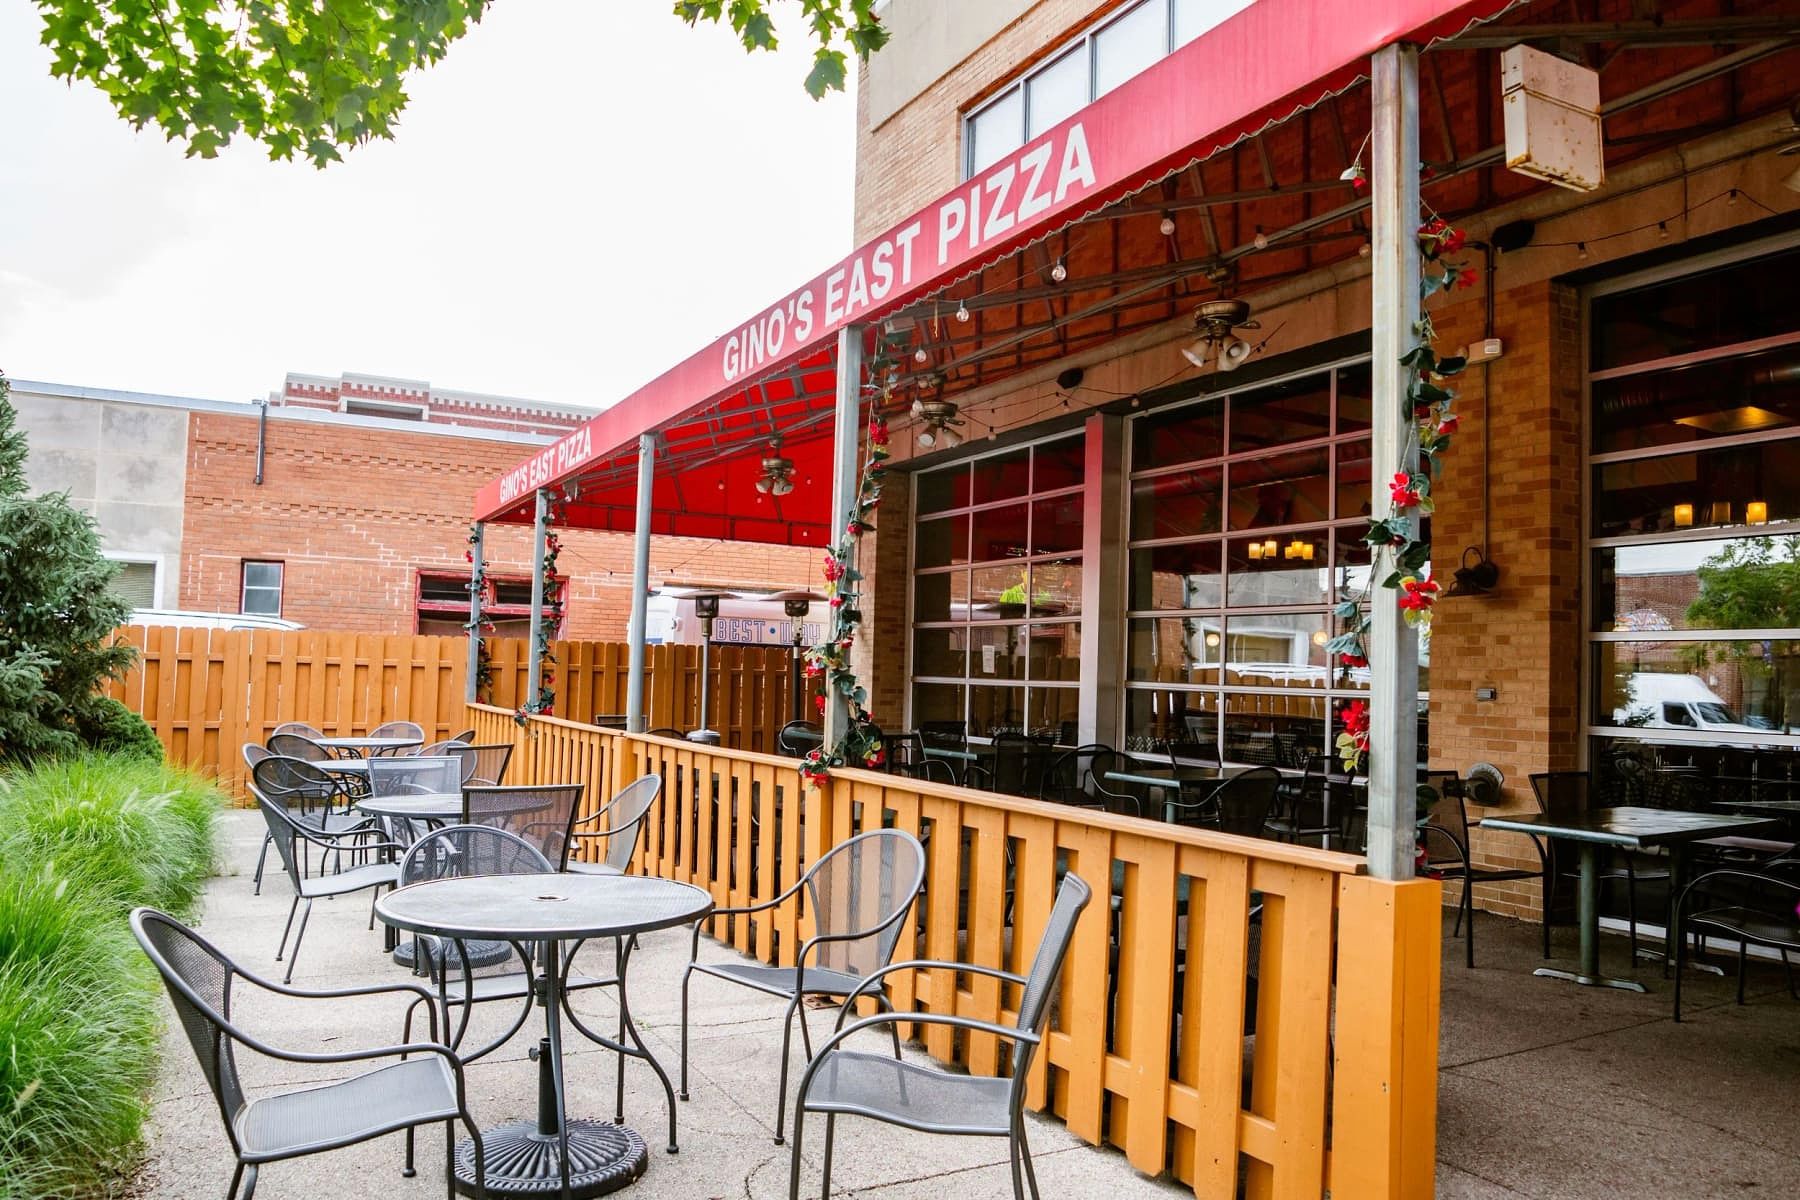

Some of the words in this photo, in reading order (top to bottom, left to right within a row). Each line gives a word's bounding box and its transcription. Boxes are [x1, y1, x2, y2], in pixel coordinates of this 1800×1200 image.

[722, 289, 815, 381] GINO'S
[824, 221, 921, 329] EAST
[938, 122, 1097, 266] PIZZA
[500, 464, 528, 504] GINO'S
[529, 447, 555, 486] EAST
[557, 426, 592, 473] PIZZA
[715, 618, 766, 643] BEST
